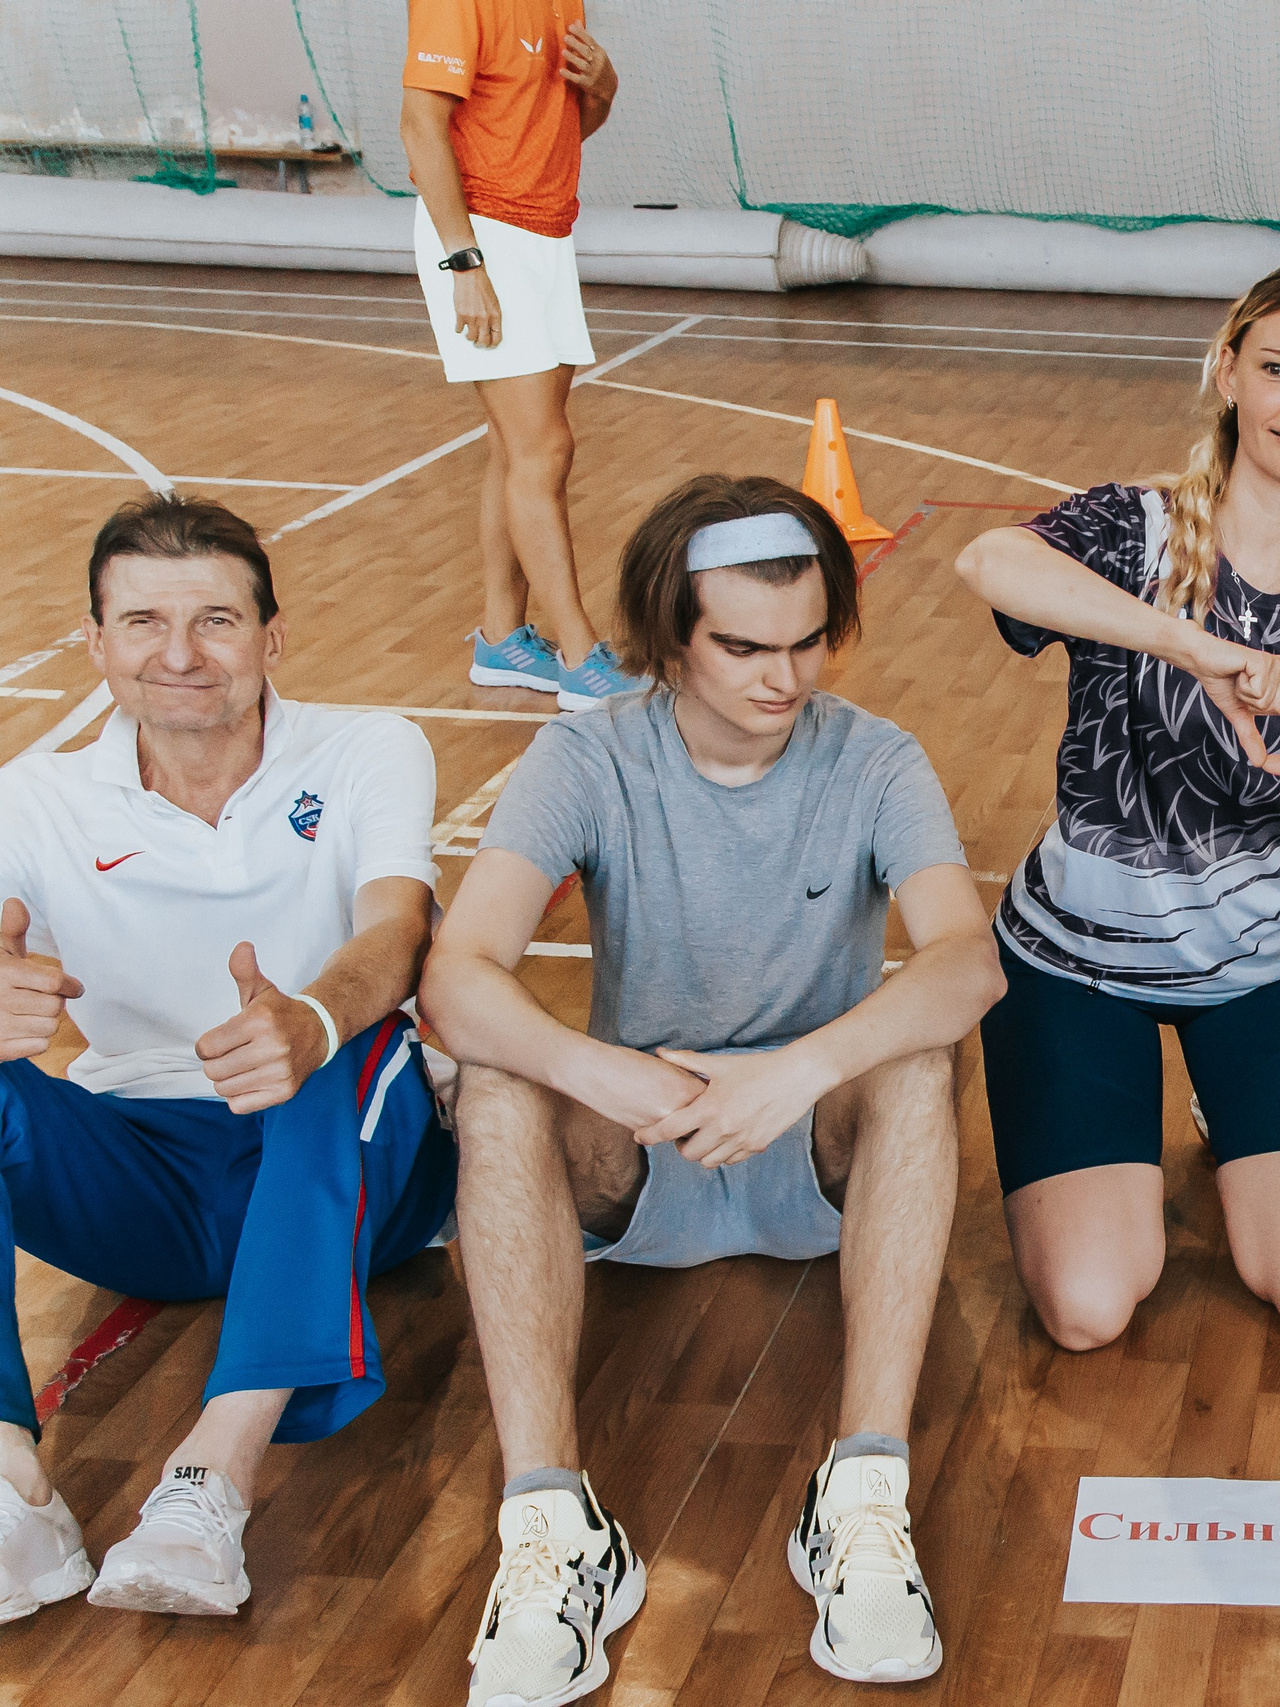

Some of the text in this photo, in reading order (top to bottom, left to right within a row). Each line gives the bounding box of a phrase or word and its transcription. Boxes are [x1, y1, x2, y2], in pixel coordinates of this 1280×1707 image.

[417, 51, 467, 67] EAZYWAY
[447, 65, 466, 76] RUN
[174, 1465, 209, 1480] SAYT
